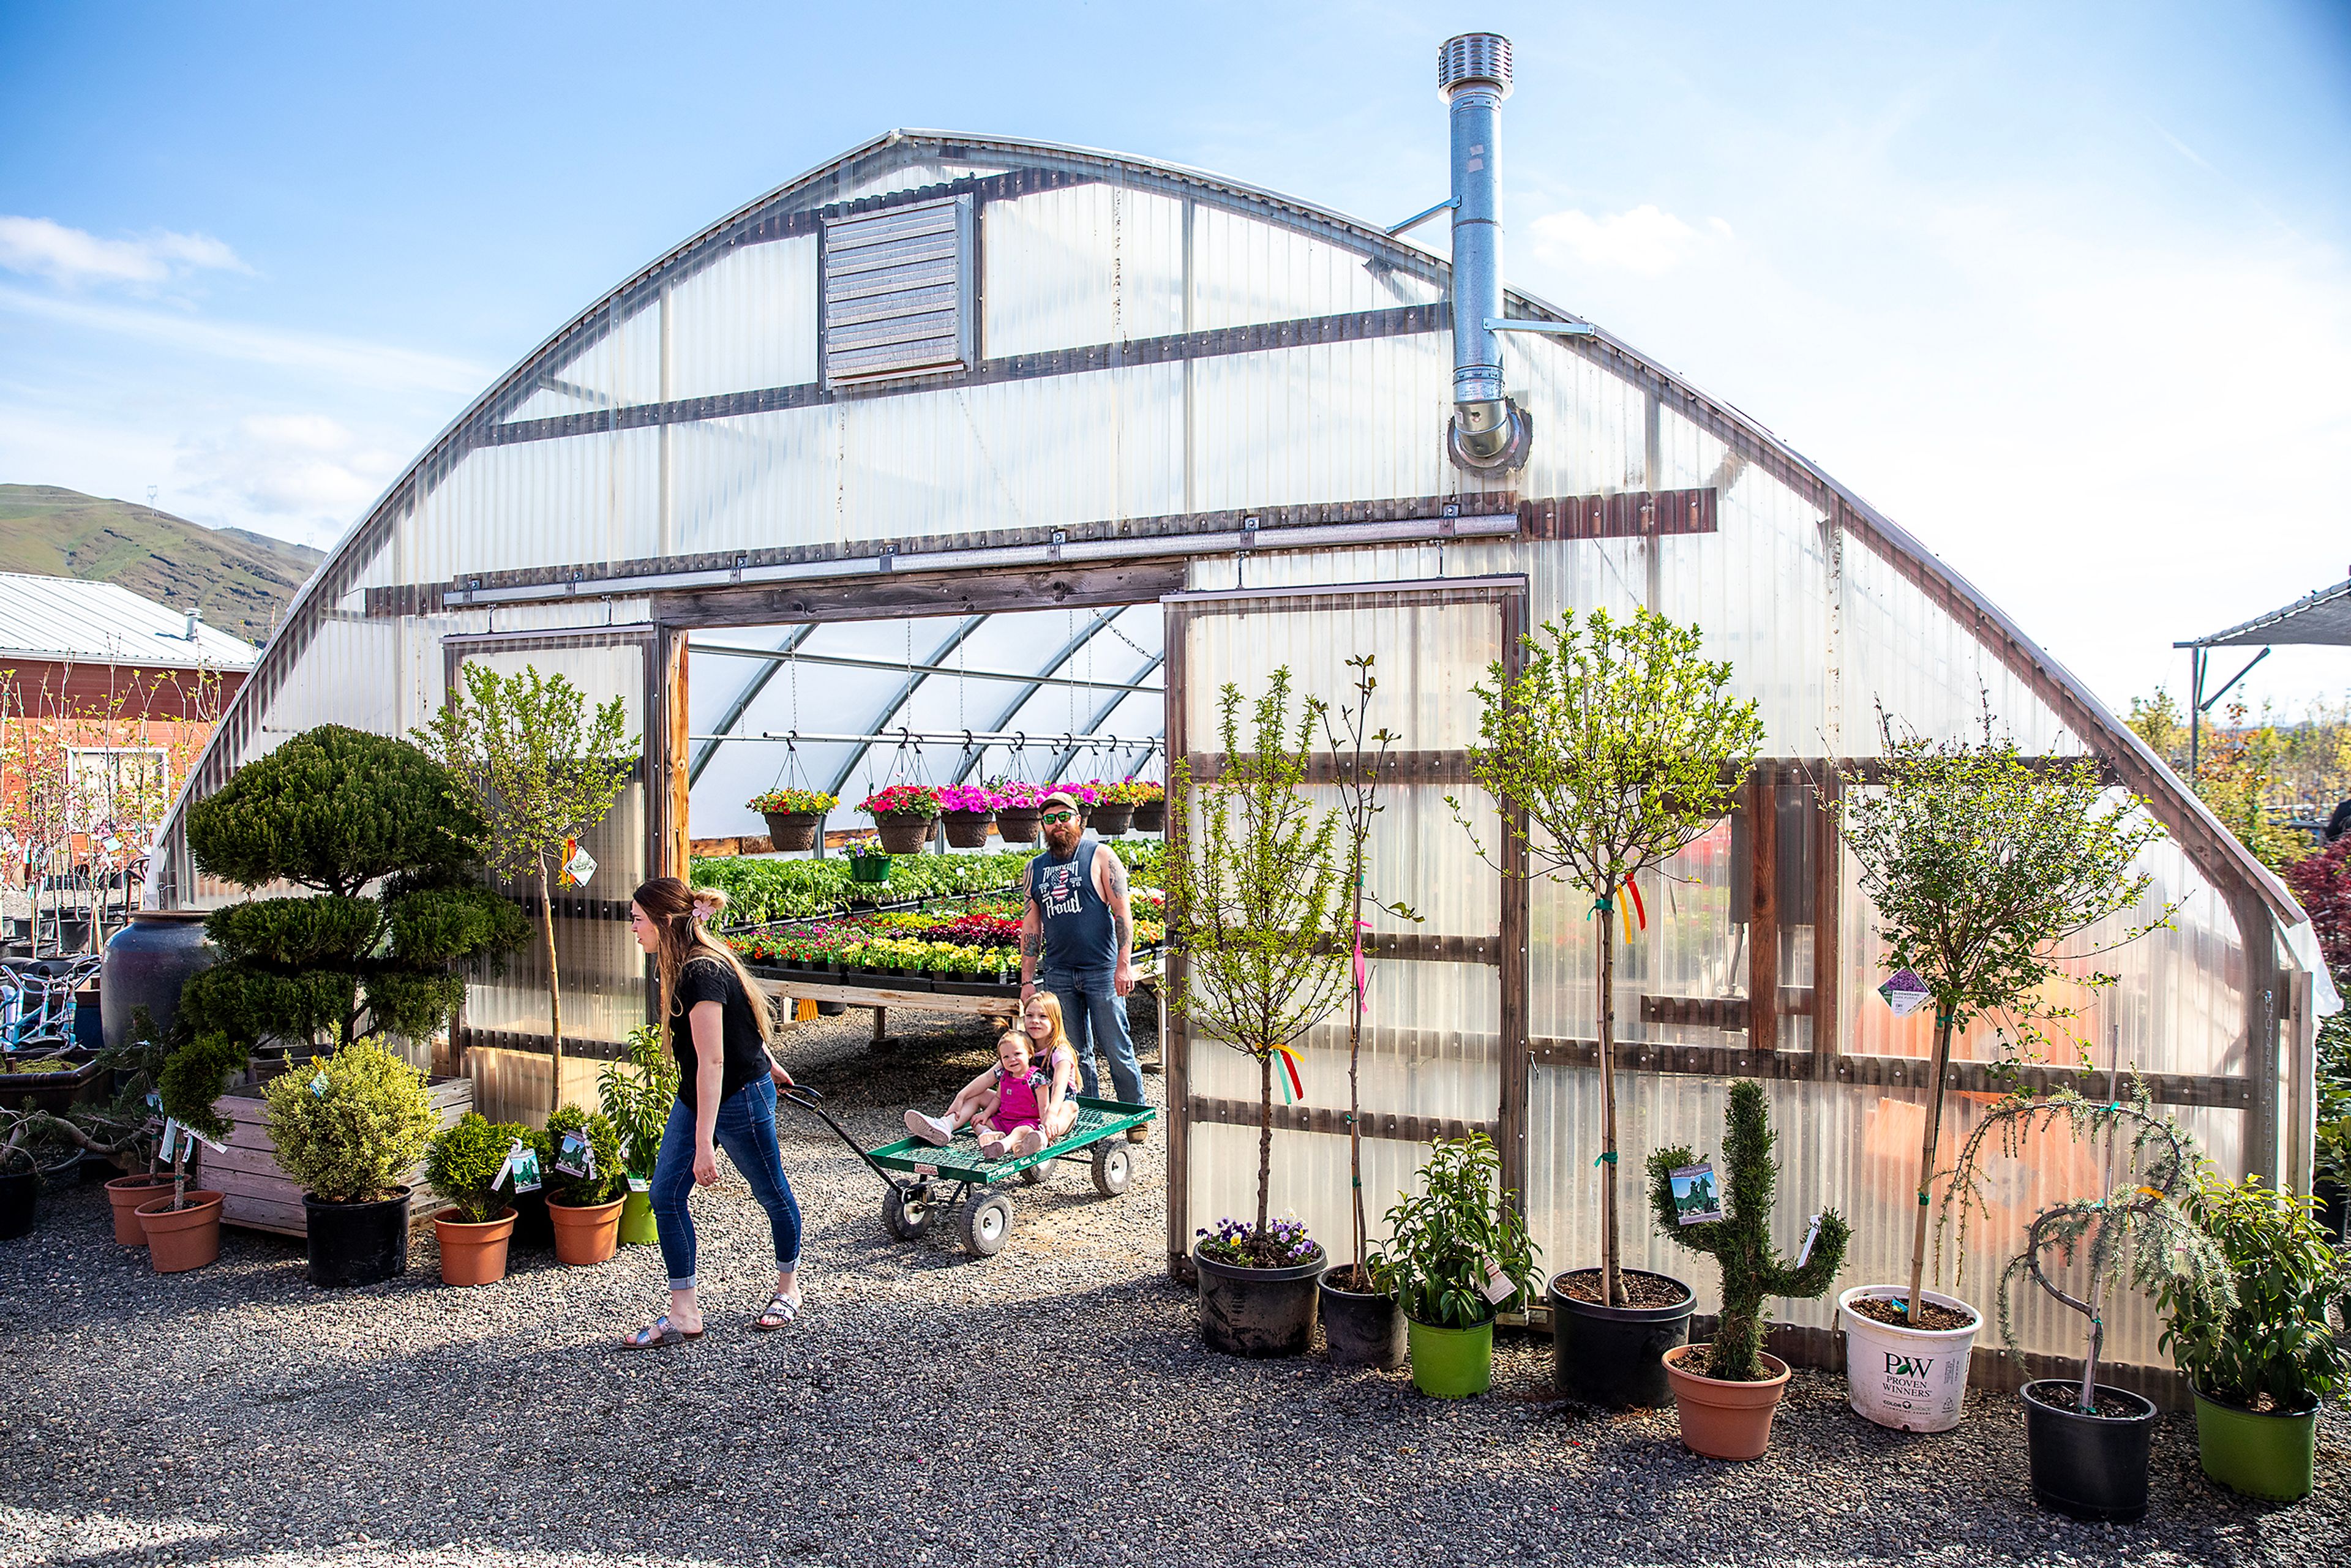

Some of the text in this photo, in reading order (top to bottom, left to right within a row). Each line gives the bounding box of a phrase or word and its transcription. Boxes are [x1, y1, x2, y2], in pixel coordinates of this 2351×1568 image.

[1043, 860, 1079, 883] American
[1042, 890, 1083, 919] Proud
[1887, 1375, 1927, 1388] PROVEN
